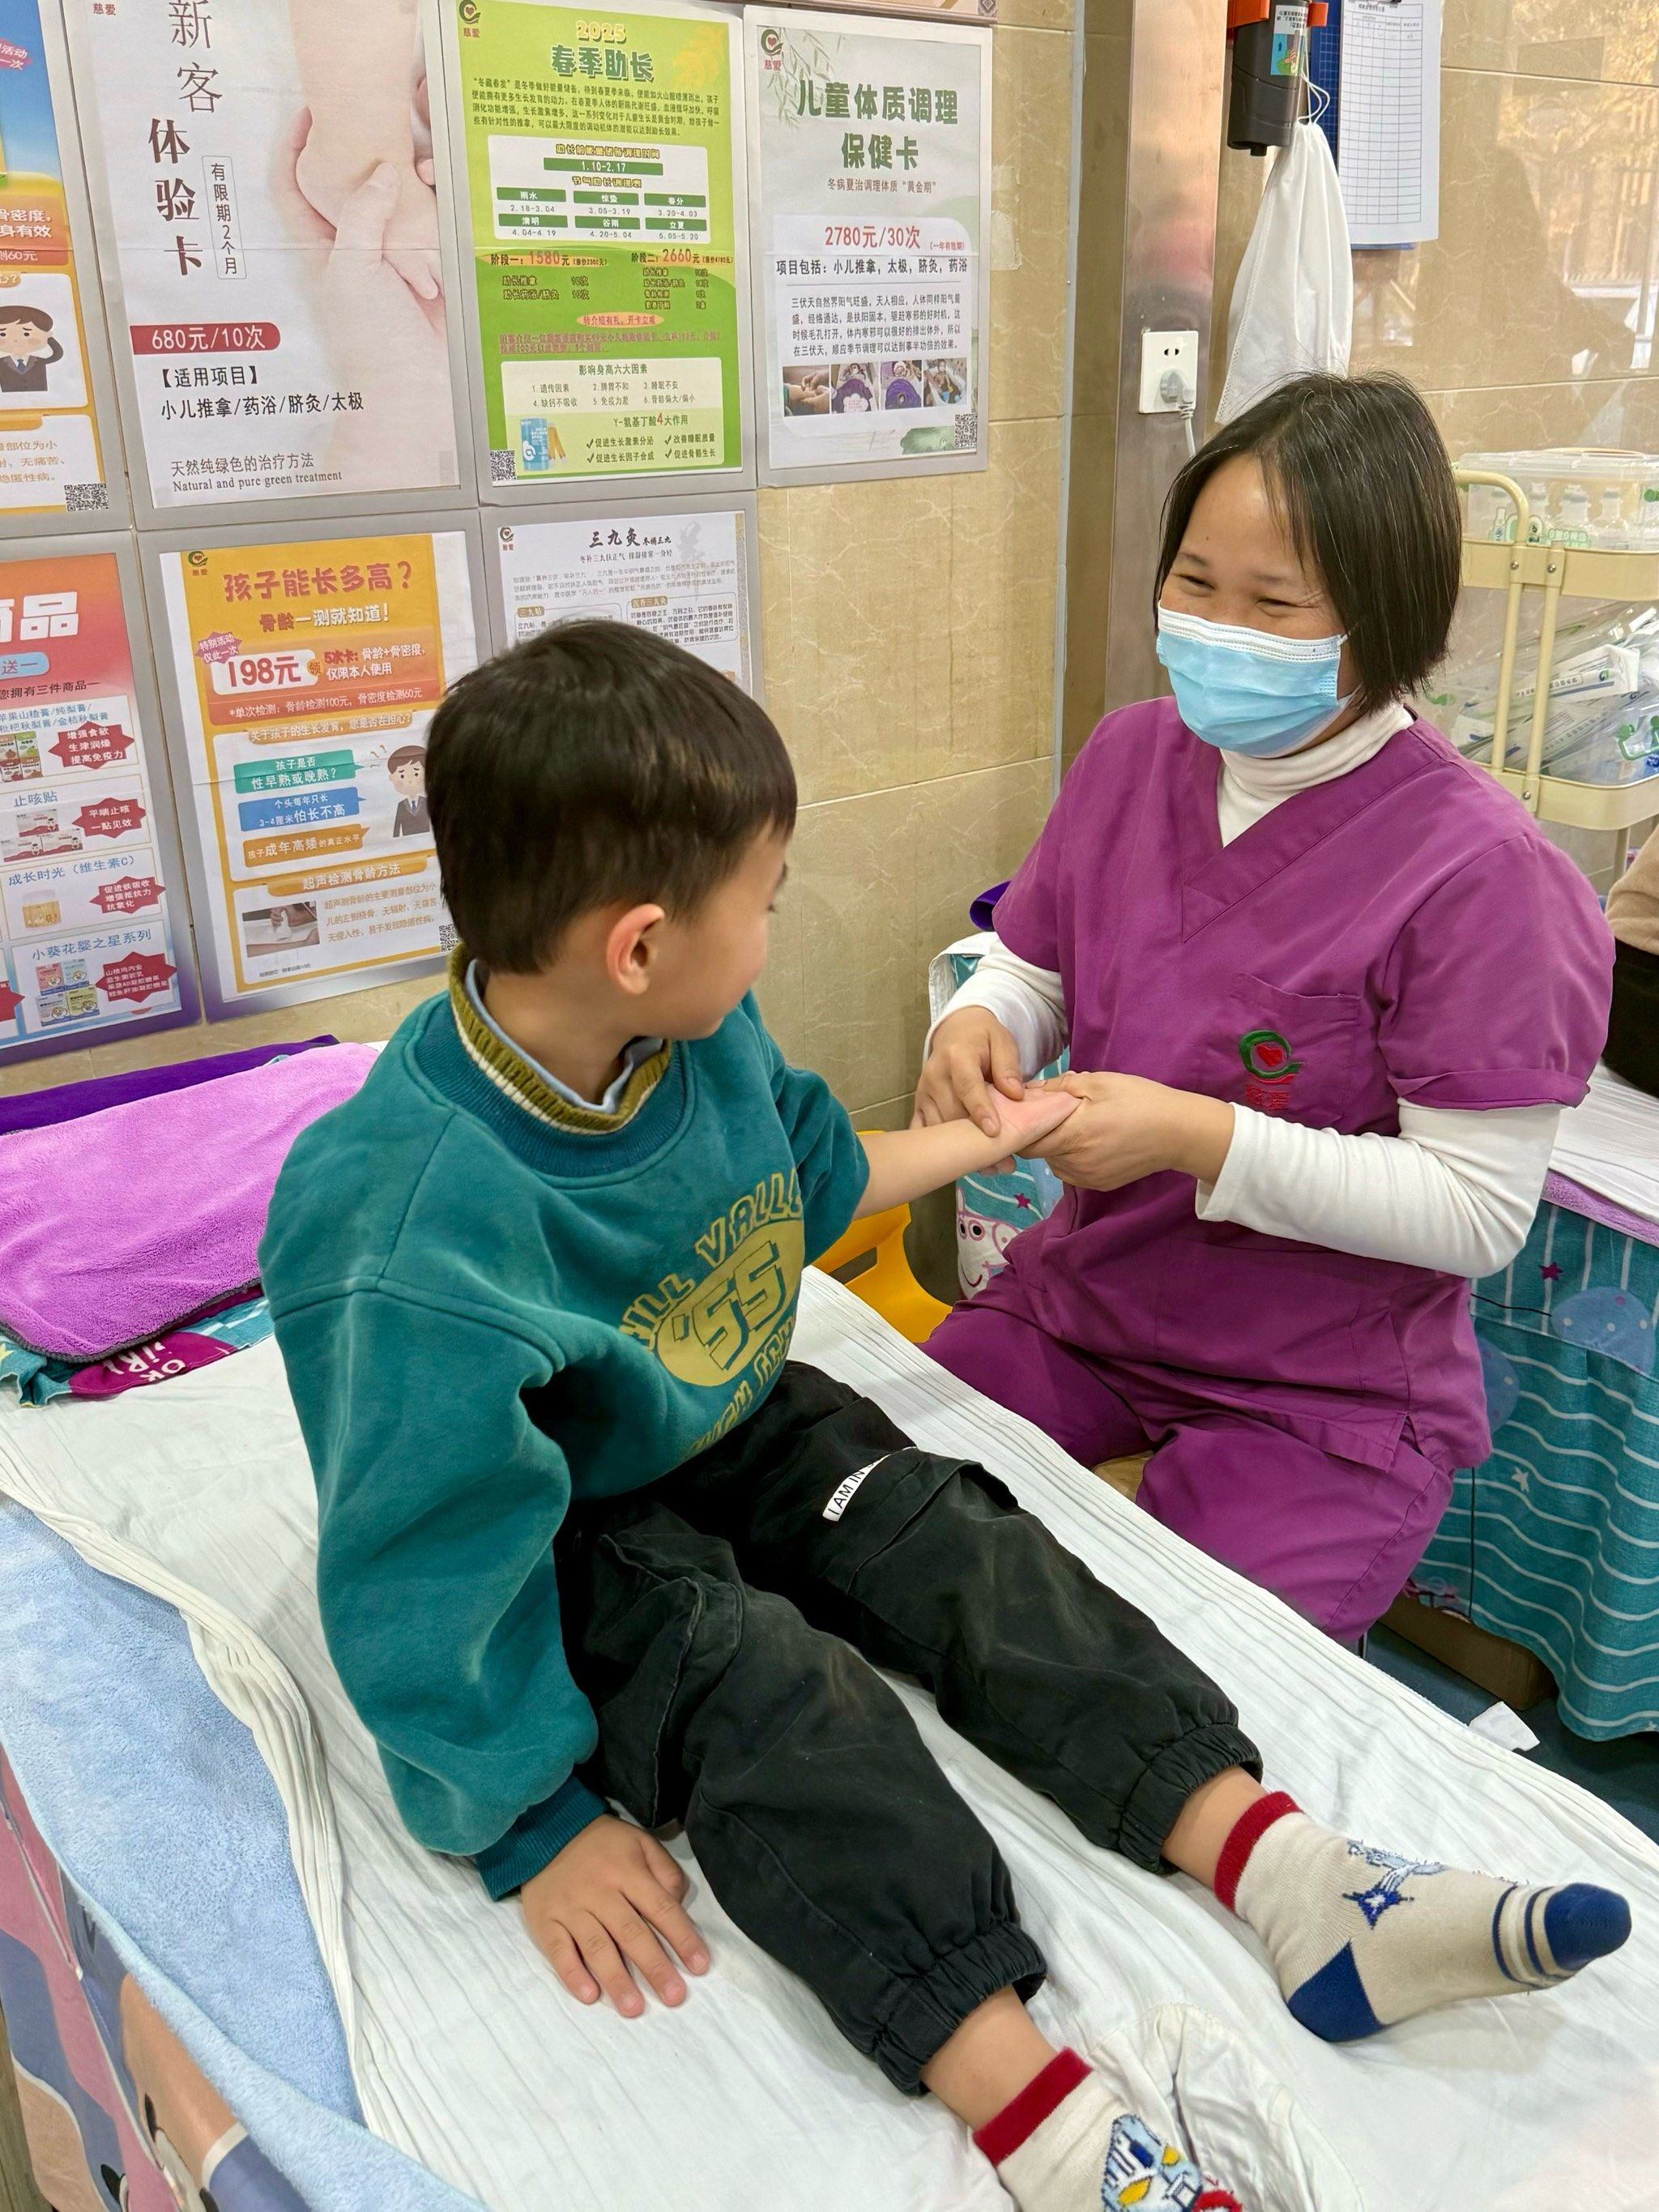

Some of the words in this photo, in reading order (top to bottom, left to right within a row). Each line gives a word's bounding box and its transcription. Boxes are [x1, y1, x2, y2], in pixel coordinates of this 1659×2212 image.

[575, 20, 627, 42] 2025
[552, 45, 654, 83] 春季助长
[797, 79, 958, 125] 儿童体质调理
[842, 133, 919, 170] 保健卡
[582, 160, 626, 173] 1.10-2.17
[148, 117, 203, 275] 体验卡
[211, 163, 237, 274] 有限期2个月
[825, 226, 921, 249] 2780元/30次
[151, 325, 266, 350] 680元/10次
[163, 365, 258, 387] 【适用项目】
[579, 364, 648, 376] 影响身高六大因素
[161, 391, 365, 419] 小儿推拿/药浴/脐灸/太极
[171, 452, 314, 476] 天然纯绿色的治疗方法
[173, 478, 212, 492] Natural
[217, 477, 235, 489] and
[239, 477, 261, 491] pure
[265, 474, 292, 489] green
[296, 470, 343, 485] treatment
[589, 527, 641, 548] 三九灸
[224, 561, 412, 603] 孩子能长多高？
[0, 591, 79, 643] 品
[259, 603, 390, 632] 骨龄一测就知道！
[199, 634, 235, 650] 特别活动
[203, 647, 239, 662] 仅此一次
[228, 655, 301, 686] 198元
[326, 664, 392, 681] 仅限本人使用
[67, 728, 109, 740] 增强食欲
[69, 739, 111, 752] 生津润燥
[71, 750, 124, 765] 提高免疫力
[275, 757, 316, 771] 孩子是否
[252, 768, 337, 791] 性早熟或晚熟？
[14, 791, 58, 808] 止咳贴
[275, 793, 328, 809] 个头每年只长
[91, 818, 133, 831] 一贴见效
[302, 863, 402, 890] 超声检测骨龄方法
[32, 929, 151, 962] 小葵花婴之星系列
[834, 1484, 854, 1510] AM
[848, 1471, 865, 1484] IN
